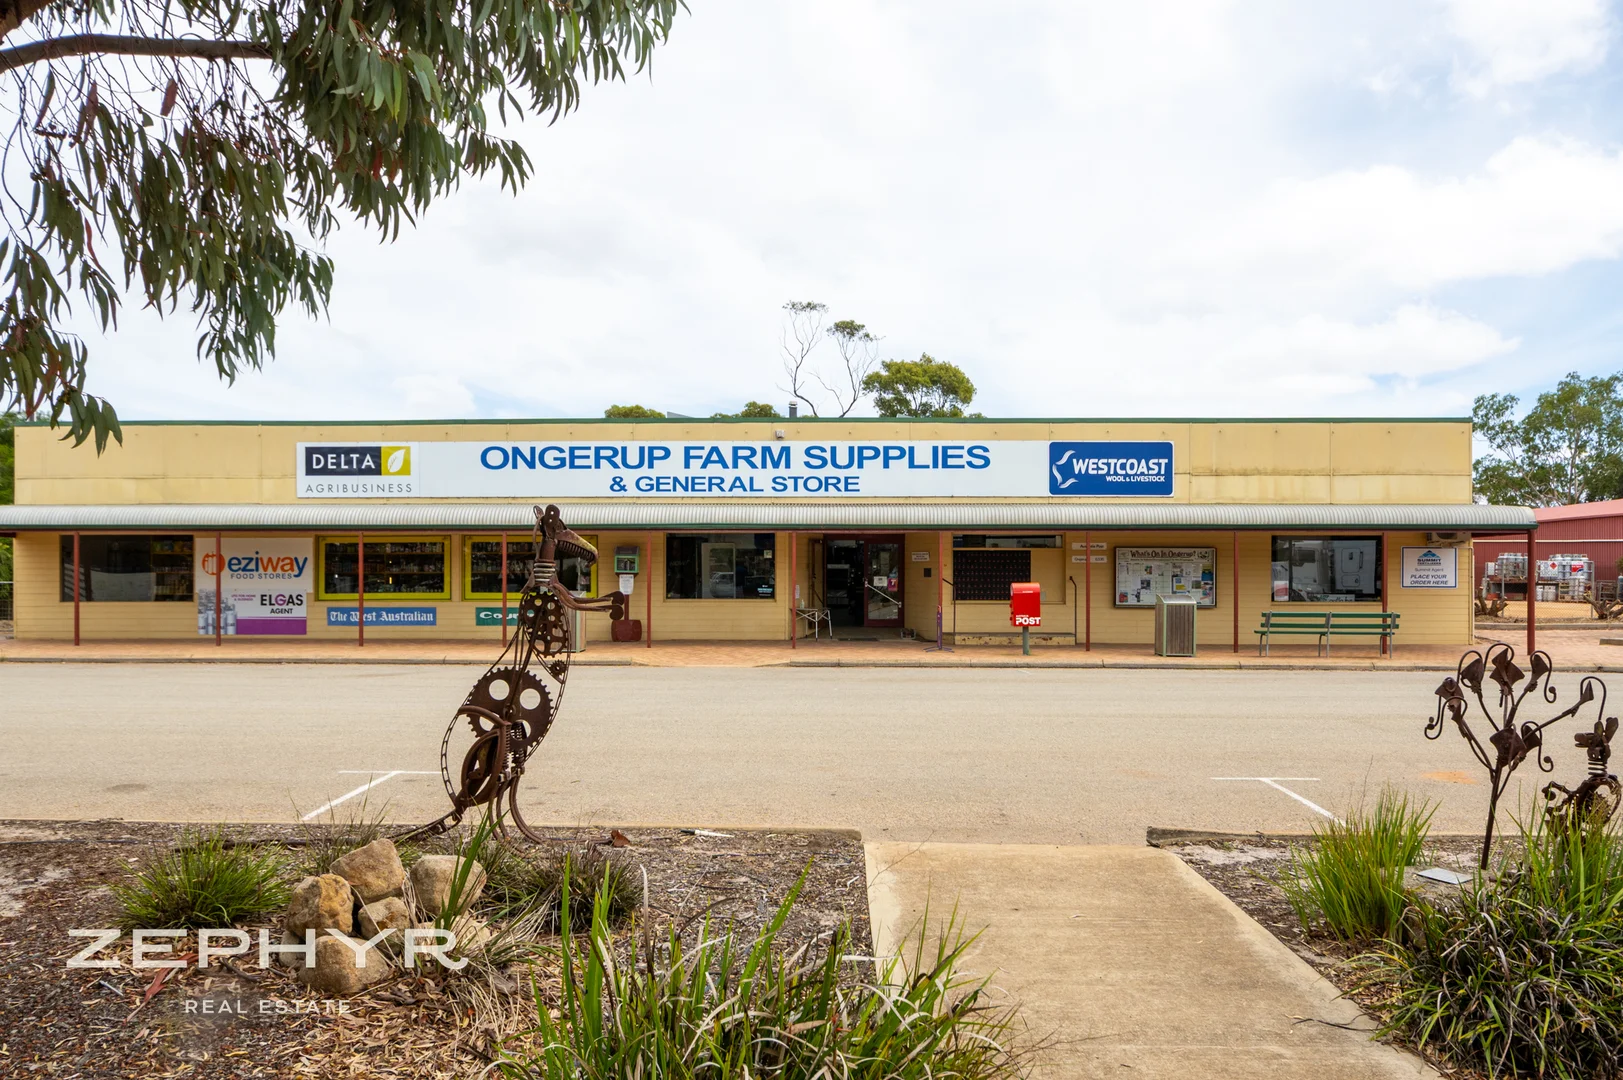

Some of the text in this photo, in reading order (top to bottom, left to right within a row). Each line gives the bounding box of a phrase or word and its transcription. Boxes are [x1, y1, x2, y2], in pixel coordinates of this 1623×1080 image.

[312, 453, 376, 469] DELTA
[480, 445, 991, 470] ONGERUP FARM SUPPLIES
[1072, 458, 1168, 475] WESTCOAST
[305, 484, 412, 493] AGRIBUSINESS
[609, 476, 860, 492] & GENERAL STORE
[228, 550, 308, 578] eziway
[260, 594, 303, 606] ELGAS
[330, 611, 434, 621] The West Australian
[1016, 617, 1041, 625] POST
